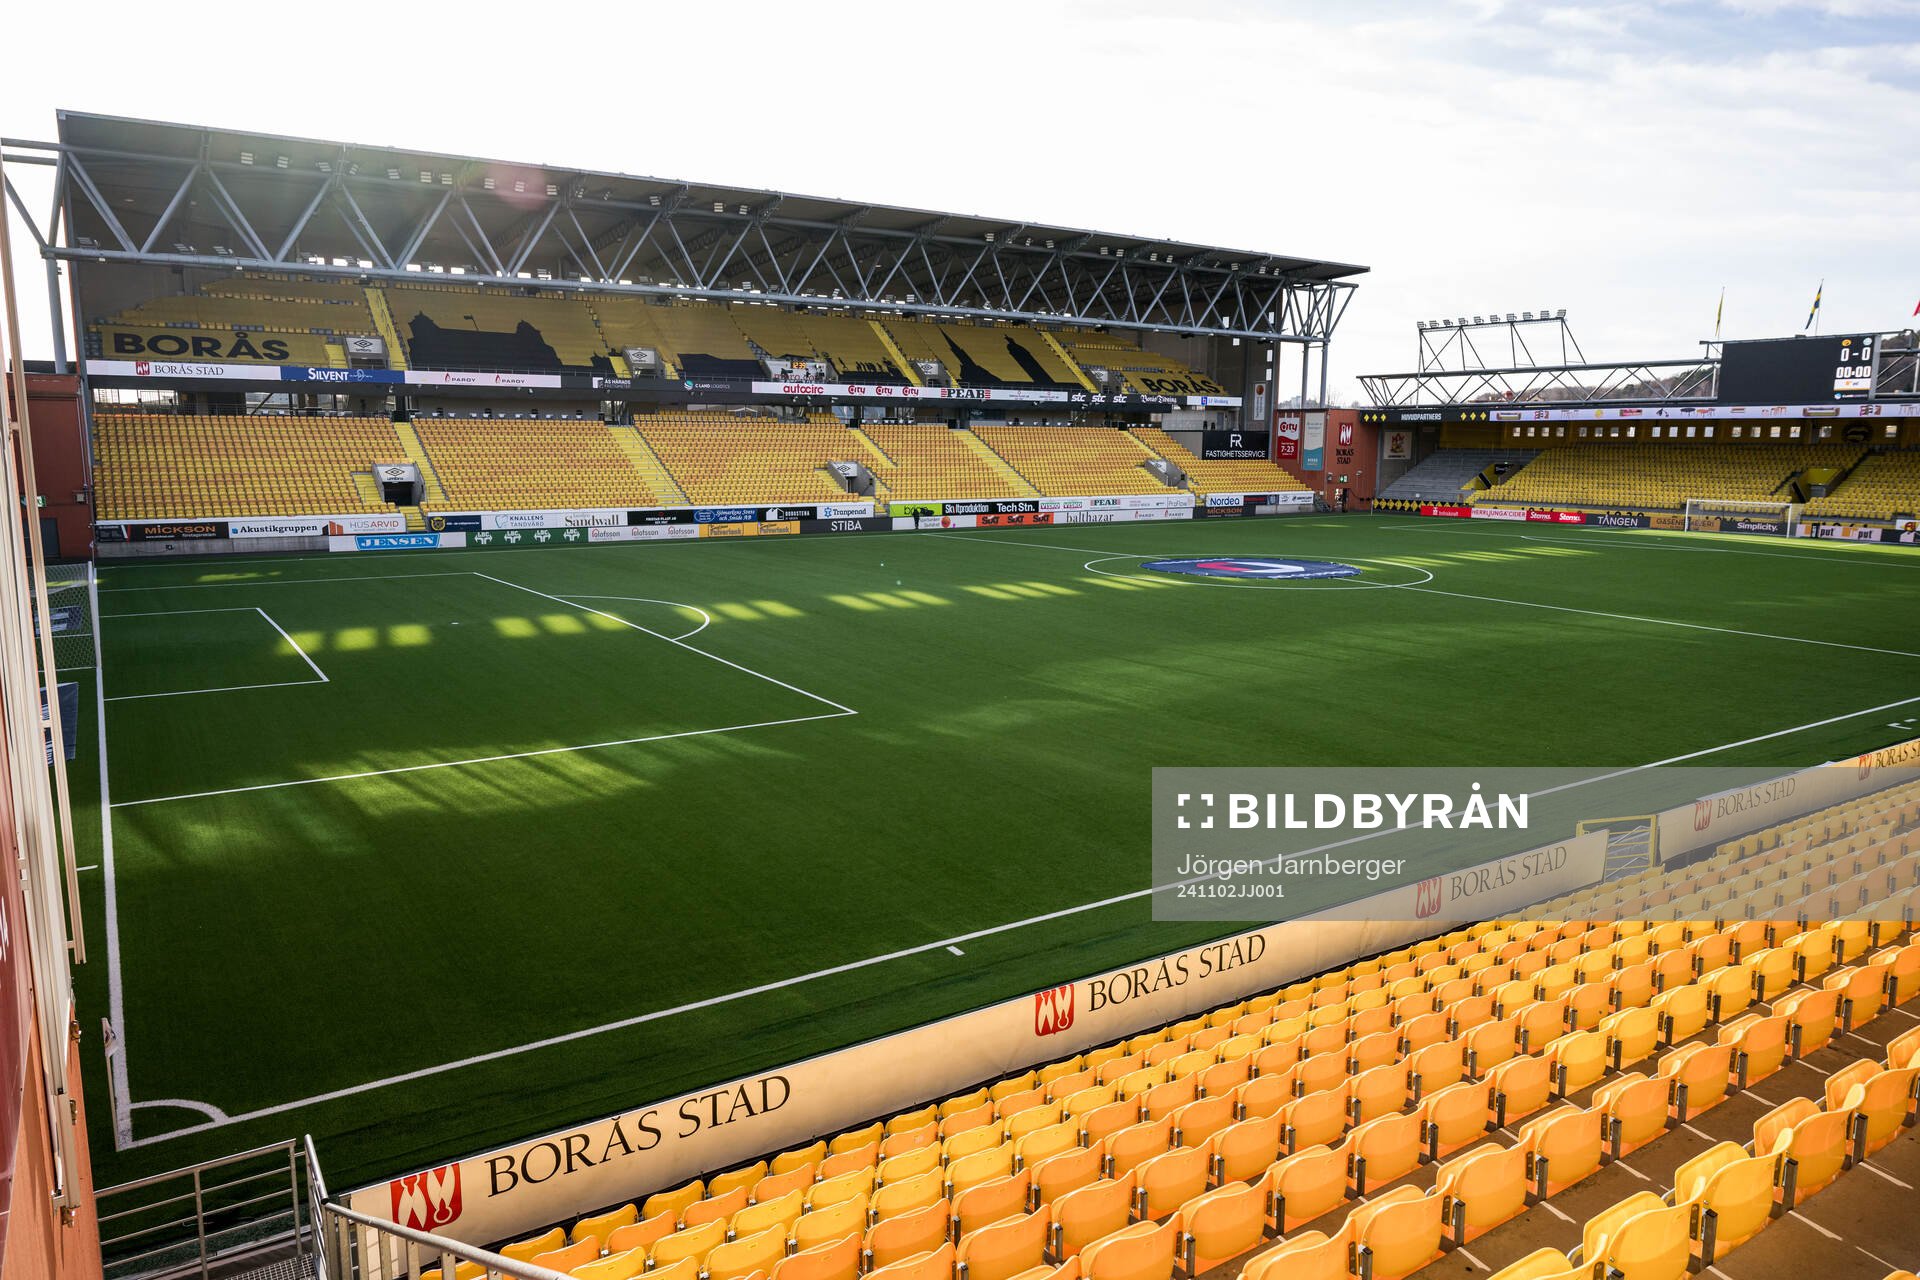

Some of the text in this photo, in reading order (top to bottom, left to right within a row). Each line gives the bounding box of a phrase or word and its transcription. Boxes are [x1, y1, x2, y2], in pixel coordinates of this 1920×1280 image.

[114, 332, 289, 361] BORÅS
[1841, 348, 1849, 361] 0
[1862, 347, 1871, 360] 0
[155, 364, 224, 376] BORÅS STAD
[308, 367, 349, 381] SILVENT
[1836, 366, 1871, 378] 00:00
[783, 385, 824, 394] autocirc
[1140, 375, 1220, 393] BORÅS
[947, 388, 985, 399] PEAB
[1205, 450, 1265, 458] FASTIGHETSSERVICE
[997, 502, 1035, 512] Tech Stn.
[1210, 497, 1240, 506] Nordea
[833, 508, 866, 516] Tranpenad
[1066, 511, 1114, 523] balthazar
[565, 514, 619, 526] Sandwall
[831, 521, 862, 531] STIBA
[240, 524, 318, 535] Akustikgruppen
[361, 536, 434, 547] JENSEN
[1875, 743, 1909, 770] BORÅS
[1716, 777, 1796, 819] BORÅS STAD
[1450, 846, 1567, 902] BORÅS STAD
[1088, 934, 1267, 1012] BORÅS STAD
[486, 1074, 793, 1198] BORÅS STAD
